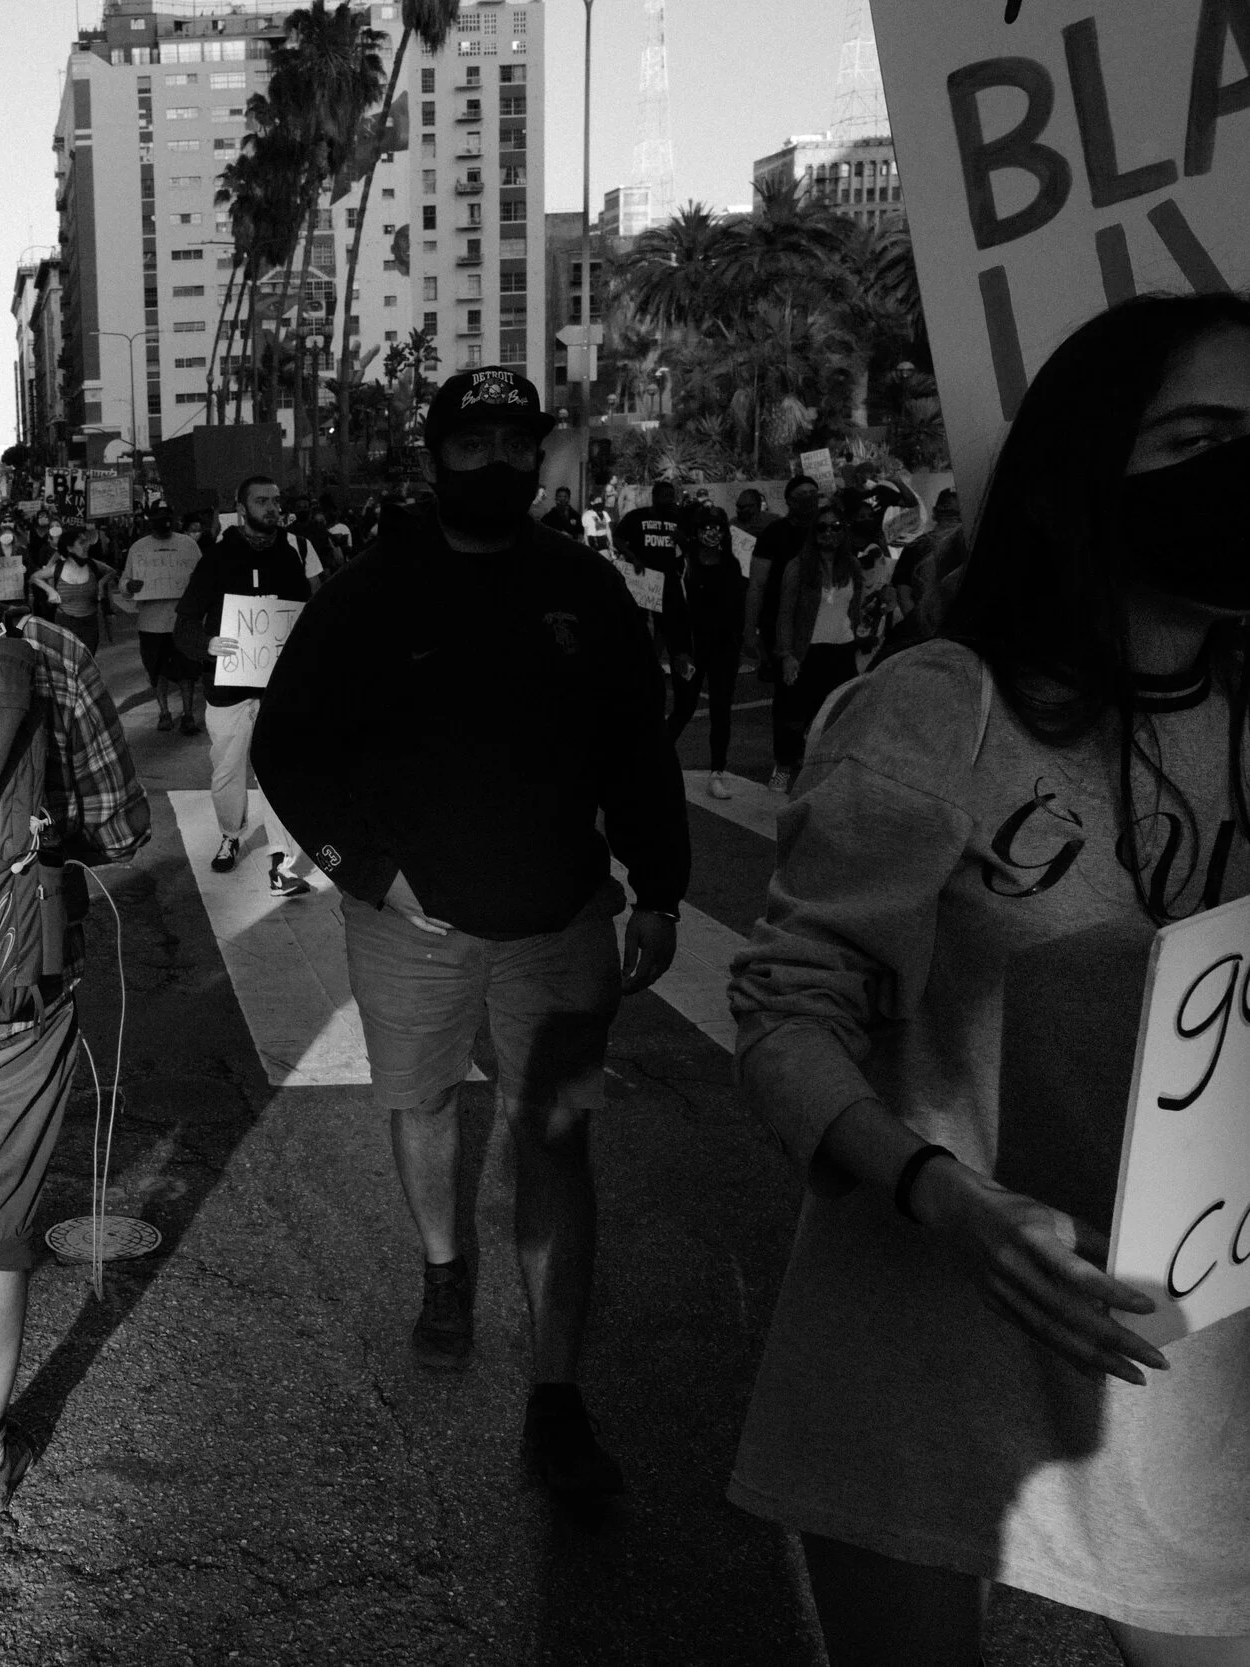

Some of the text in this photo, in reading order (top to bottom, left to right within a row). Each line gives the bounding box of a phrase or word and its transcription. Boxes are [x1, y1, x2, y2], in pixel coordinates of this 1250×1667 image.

[472, 370, 515, 387] DETROIT
[641, 519, 662, 531] FIGHT
[237, 609, 270, 638] NO
[240, 645, 271, 675] NO
